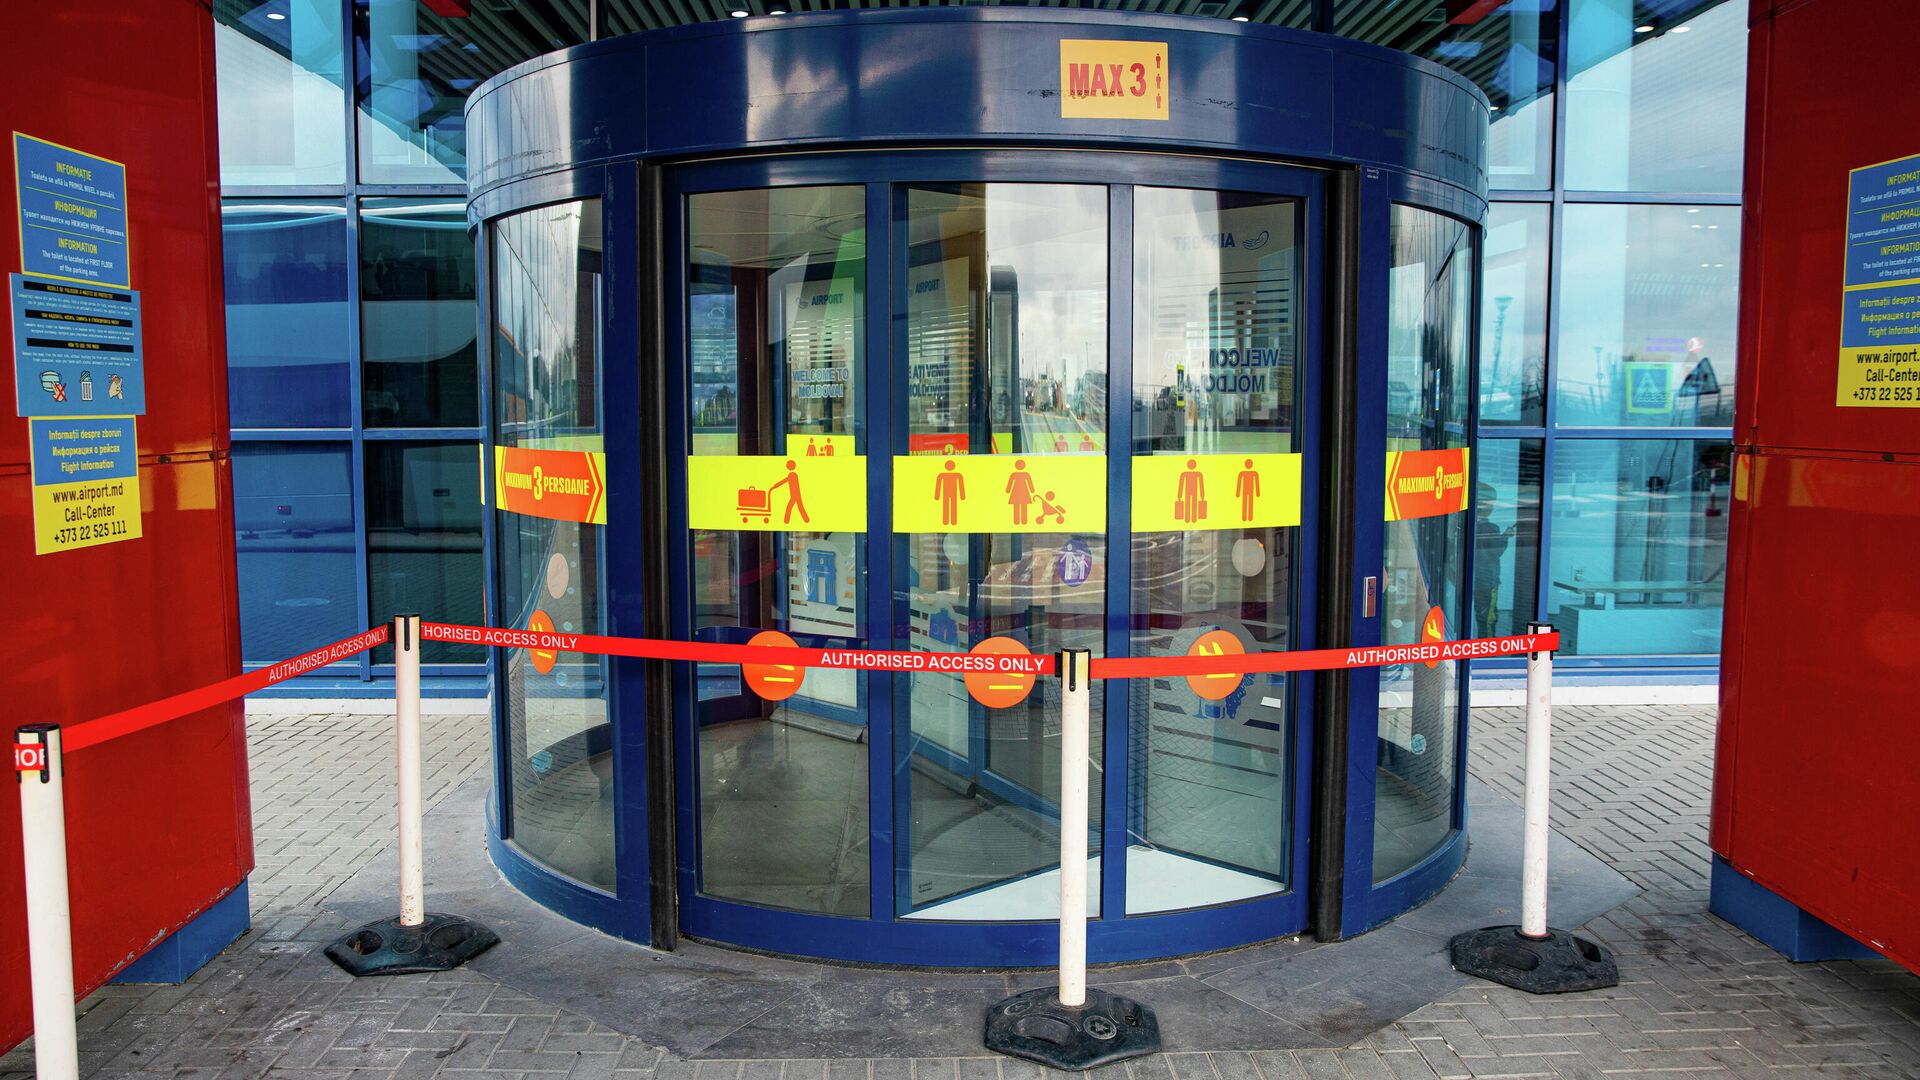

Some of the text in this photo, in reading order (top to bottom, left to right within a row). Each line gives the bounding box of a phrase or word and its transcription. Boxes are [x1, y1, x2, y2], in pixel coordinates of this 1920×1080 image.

[1070, 62, 1147, 97] MAX 3
[58, 238, 97, 254] INFORMATION
[915, 279, 940, 293] AIRPORT
[811, 293, 844, 306] AIRPORT
[1892, 296, 1914, 306] despre
[1868, 327, 1887, 338] Flight
[792, 368, 849, 382] WELCOME TO
[798, 384, 843, 398] MOLDOVA!
[1853, 387, 1876, 400] +373
[1879, 387, 1891, 400] 22
[1894, 387, 1912, 400] 525
[81, 429, 100, 441] despre
[102, 428, 121, 438] zboruri
[53, 446, 93, 458] Информация
[100, 443, 120, 456] рейсах
[61, 461, 80, 474] Flight
[505, 466, 590, 500] MAXIMUM 3 PERSOANE
[1399, 466, 1463, 500] MAXIMUM 3 PERSOANE
[53, 482, 123, 503] www.airport.md
[65, 504, 115, 522] Call-Center
[54, 520, 127, 544] +373 22 525 111
[485, 631, 538, 646] ACCESS
[541, 634, 577, 648] ONLY
[269, 628, 387, 682] AUTHORISED ACCESS ONLY
[1347, 638, 1536, 665] AUTHORISED ACCESS ONLY
[821, 652, 1045, 671] AUTHORISED ACCESS ONLY
